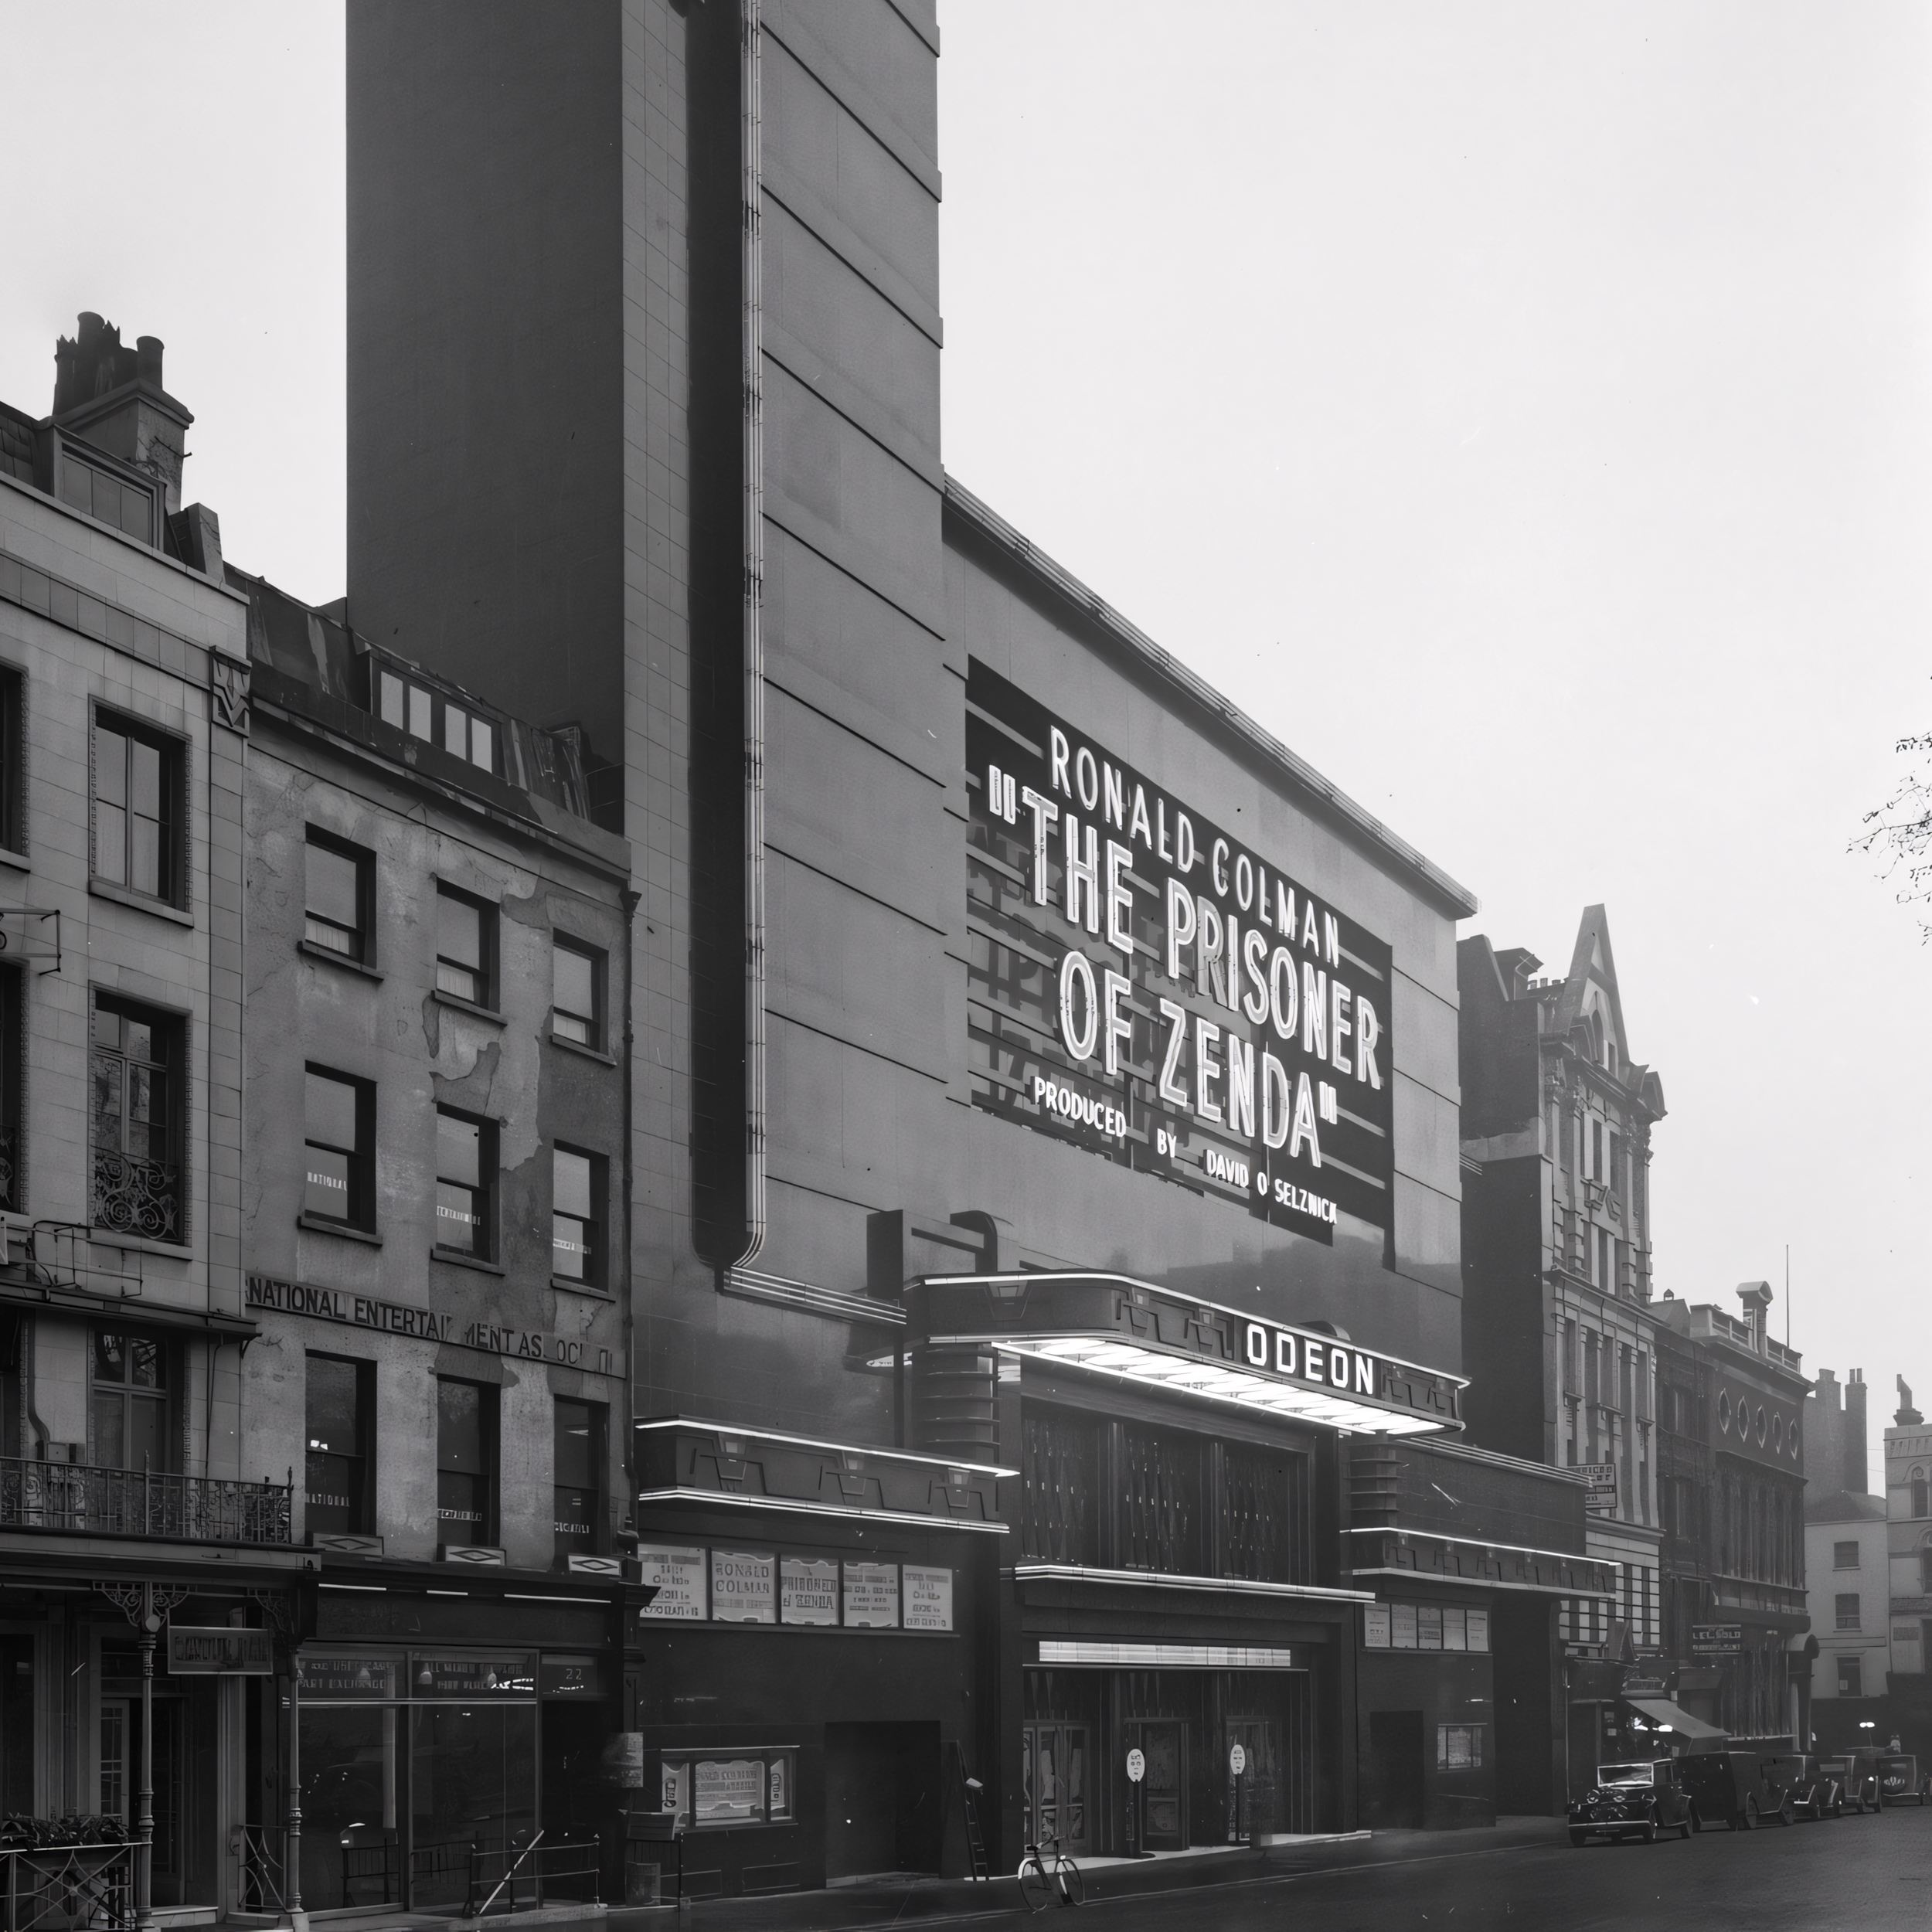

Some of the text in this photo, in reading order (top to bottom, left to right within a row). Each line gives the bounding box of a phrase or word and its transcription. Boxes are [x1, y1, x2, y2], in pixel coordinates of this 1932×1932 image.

[1050, 725, 1339, 969] RONALD COLMAN
[1059, 950, 1132, 1076] OF
[1164, 877, 1382, 1090] PRISONER
[1032, 1075, 1338, 1226] PRODUCED BY DAVID O SELZNICK
[1247, 1322, 1374, 1395] ODEON
